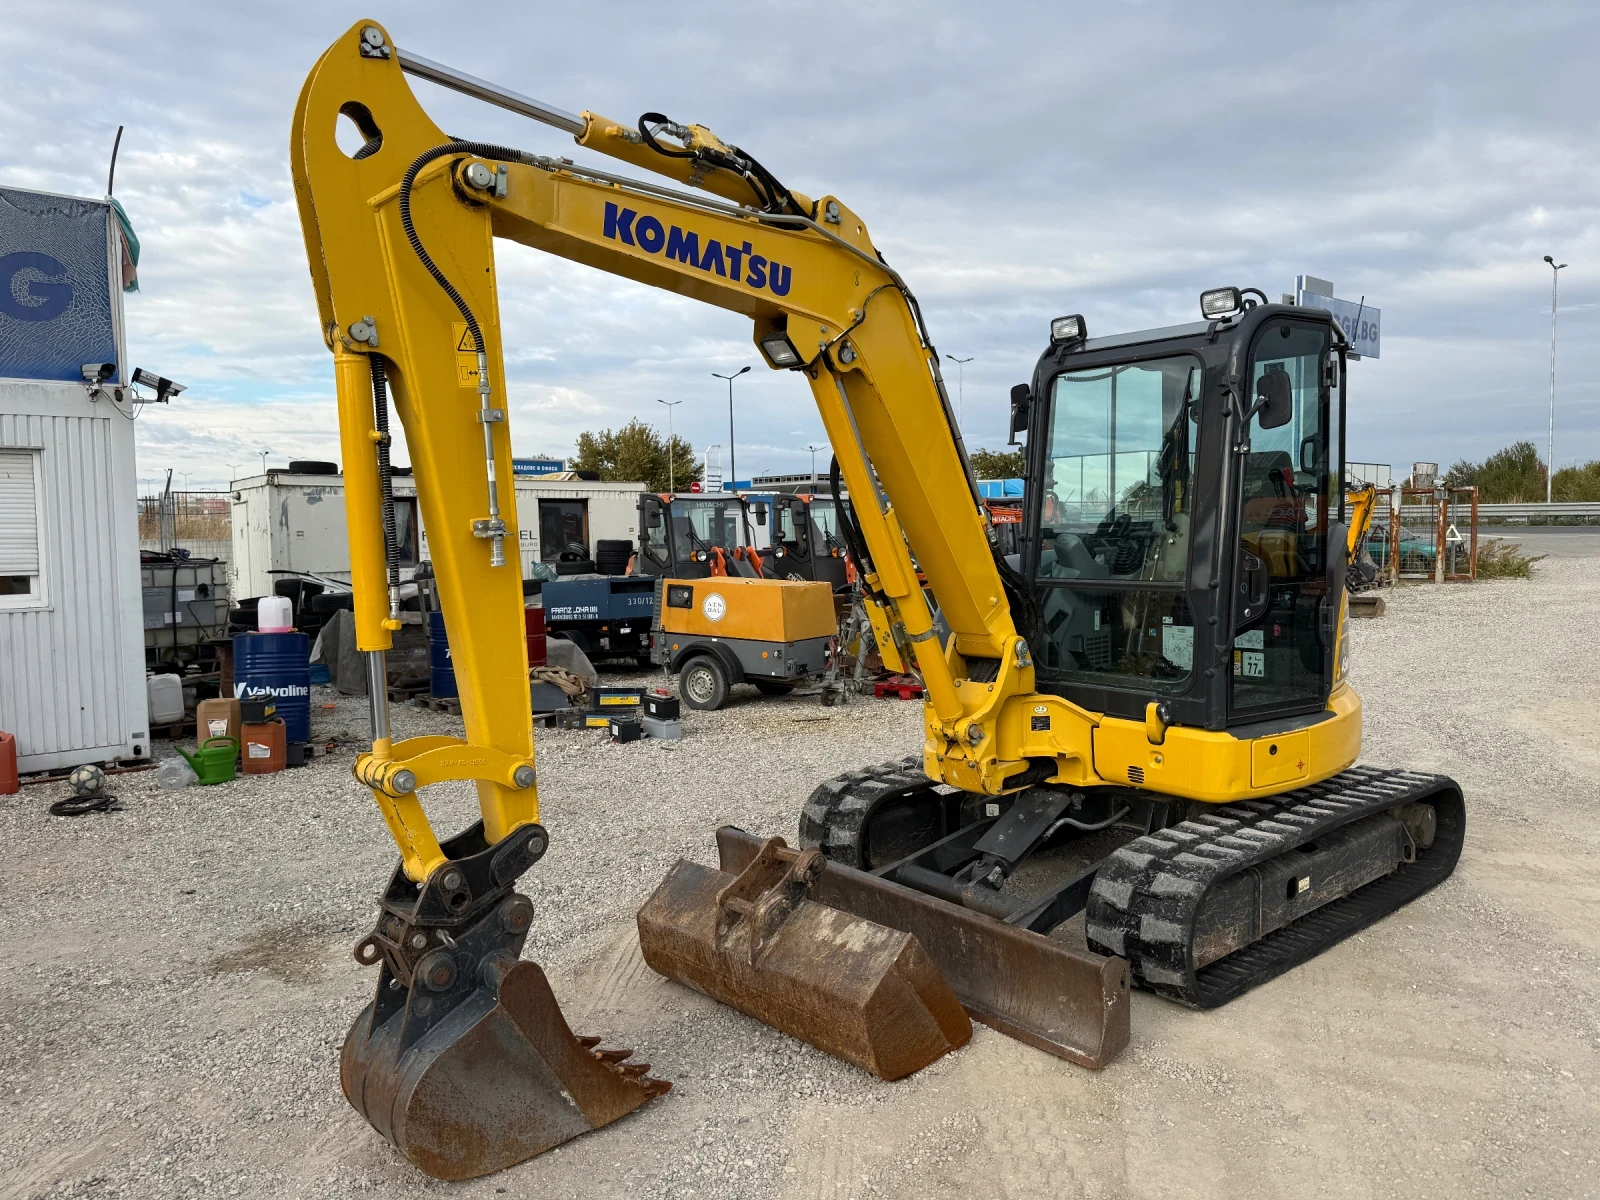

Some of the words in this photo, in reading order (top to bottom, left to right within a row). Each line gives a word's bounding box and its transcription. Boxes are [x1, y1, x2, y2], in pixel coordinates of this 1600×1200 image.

[603, 201, 792, 297] KOMATSU
[1247, 662, 1258, 674] 77
[247, 685, 308, 697] Valvoline
